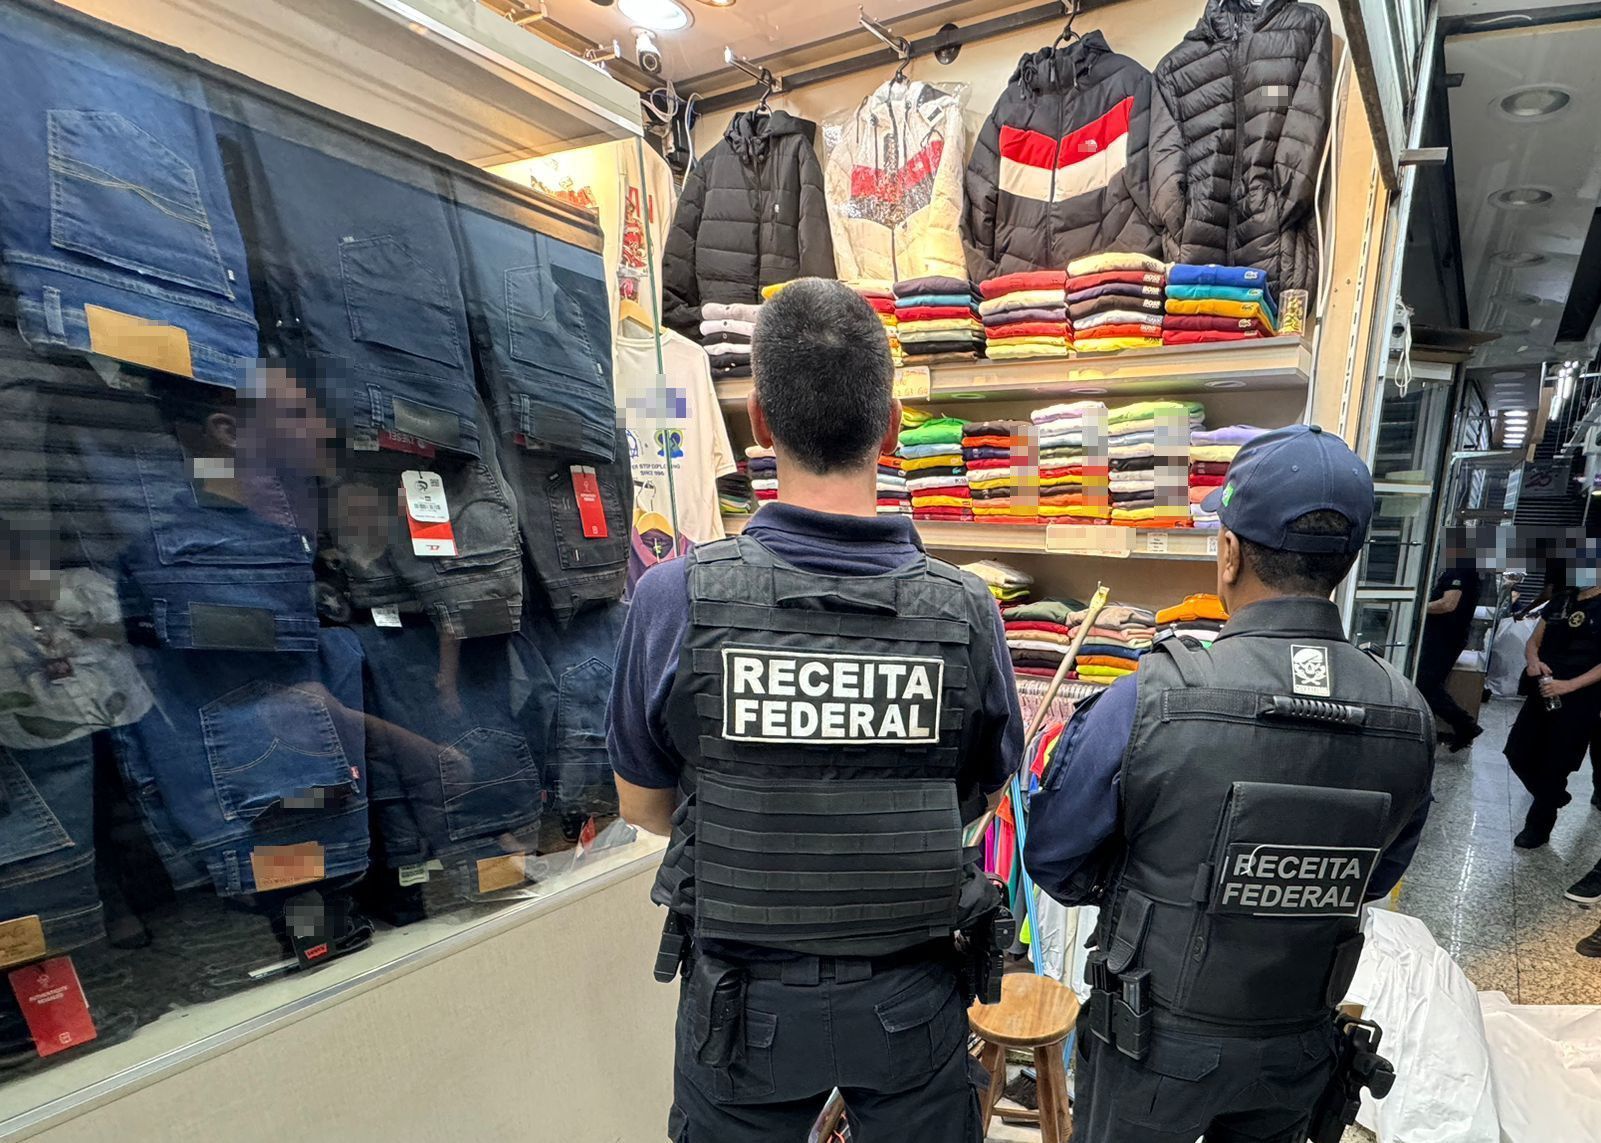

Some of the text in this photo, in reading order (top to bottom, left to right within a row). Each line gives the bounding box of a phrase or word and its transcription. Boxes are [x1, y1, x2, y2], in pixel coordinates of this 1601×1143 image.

[1143, 299, 1160, 307] BOSS
[733, 657, 933, 700] RECEITA
[734, 698, 930, 738] FEDERAL
[1233, 854, 1361, 879] RECEITA
[1222, 882, 1355, 908] FEDERAL
